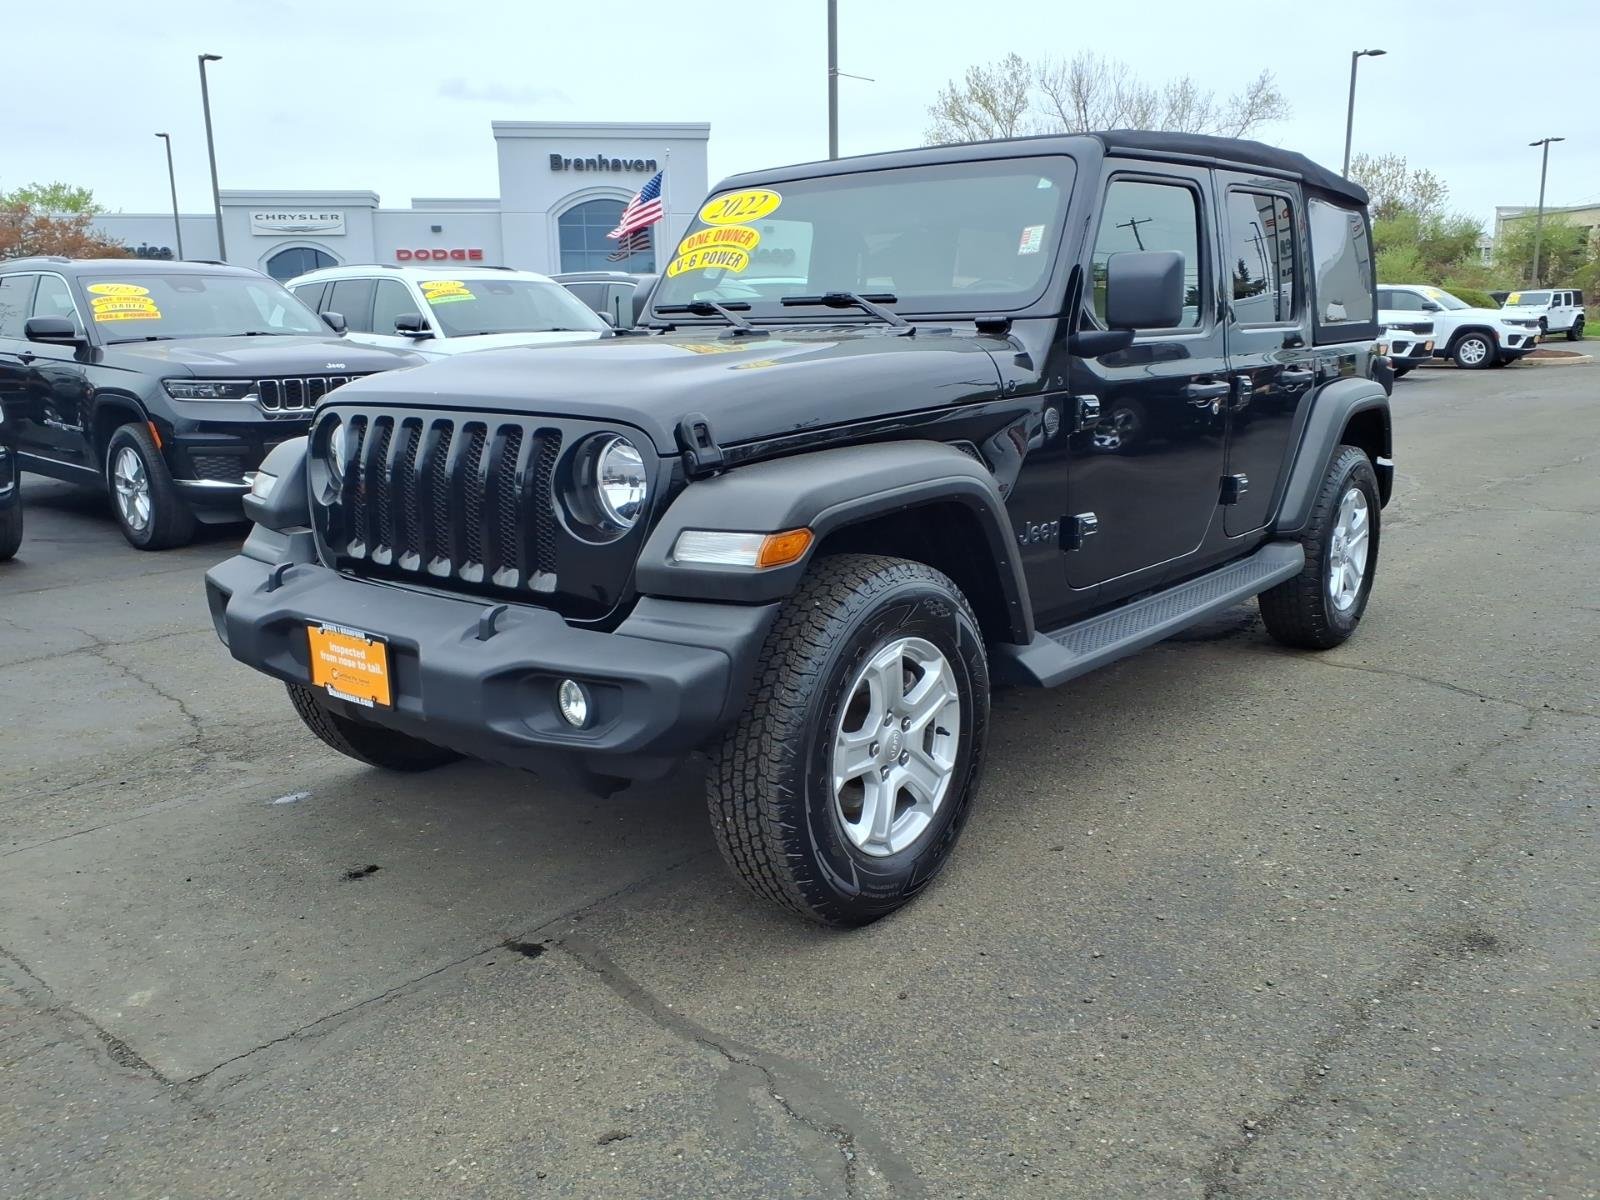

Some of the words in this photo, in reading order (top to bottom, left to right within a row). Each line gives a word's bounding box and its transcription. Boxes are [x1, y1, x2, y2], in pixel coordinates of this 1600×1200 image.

[549, 153, 657, 172] Branhaven
[709, 194, 769, 219] 2022
[254, 213, 340, 221] CHRYSLER
[687, 231, 711, 249] ONE
[713, 229, 755, 246] OWNER
[396, 249, 483, 261] DODGE
[676, 254, 698, 271] V-6
[700, 250, 744, 268] POWER
[1019, 520, 1059, 546] Jeep
[320, 650, 337, 663] from
[338, 657, 357, 669] nose
[357, 660, 367, 671] to
